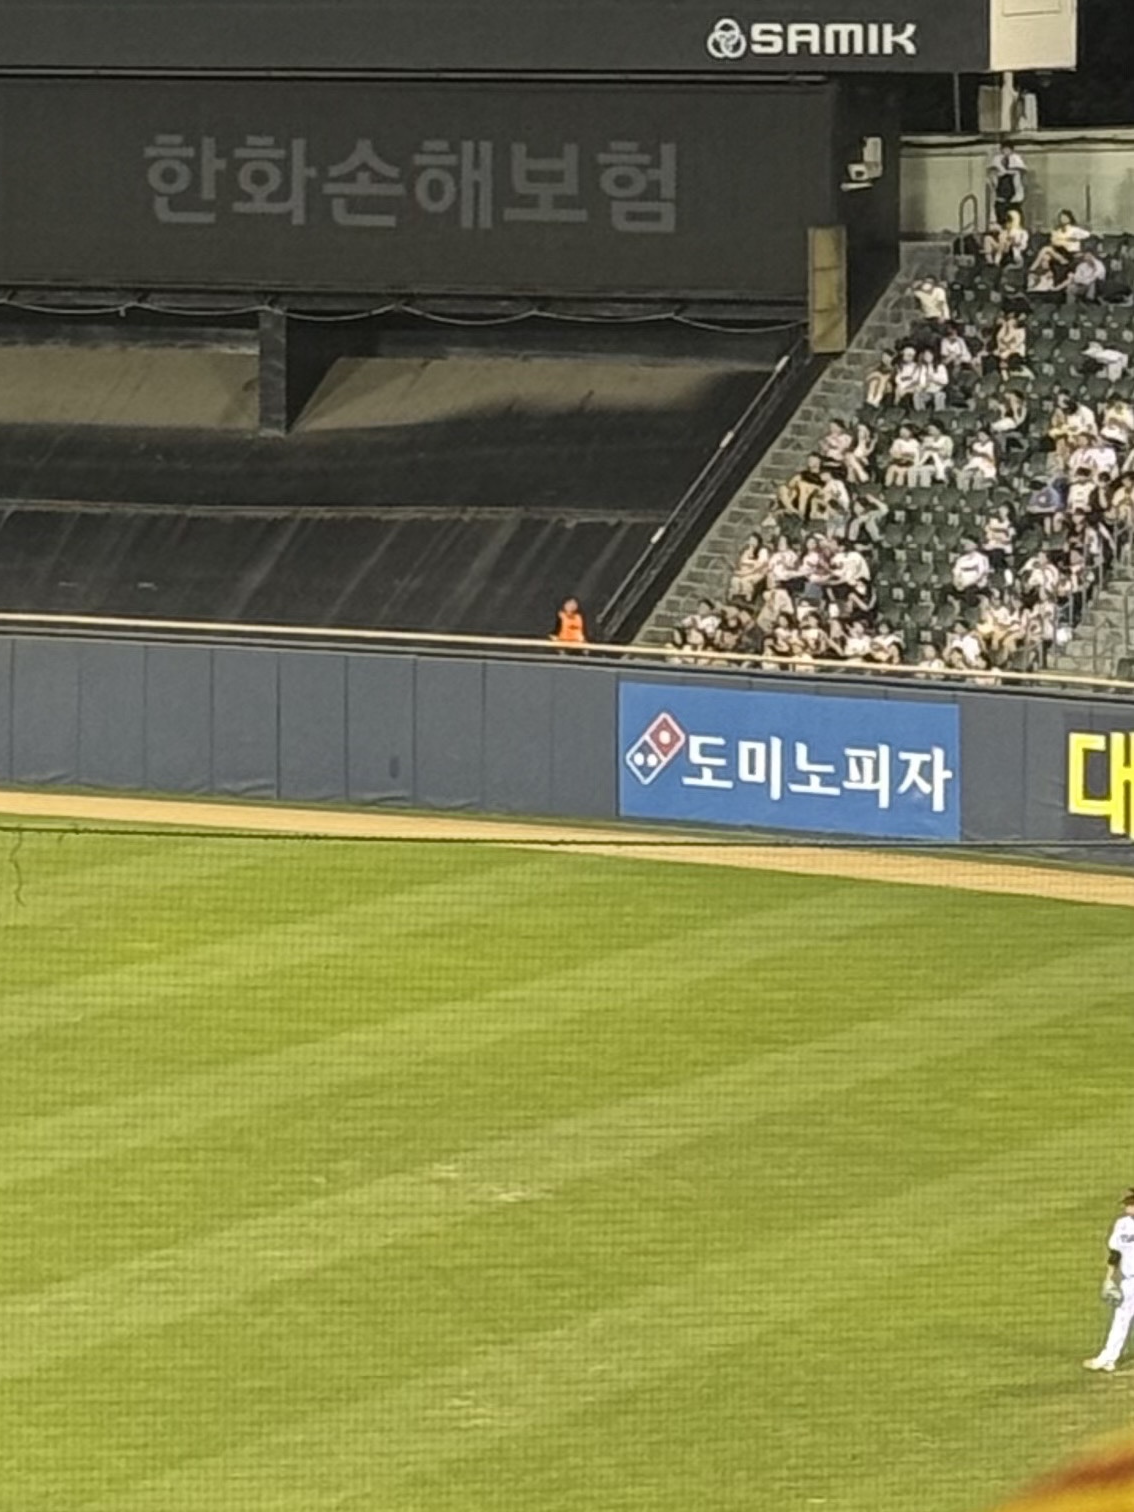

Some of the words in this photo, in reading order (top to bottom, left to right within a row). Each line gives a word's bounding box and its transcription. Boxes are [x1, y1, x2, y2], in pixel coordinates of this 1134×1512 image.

[750, 22, 917, 55] SAMIK
[143, 133, 676, 235] 한화손해보험
[682, 733, 952, 812] 도미노피자
